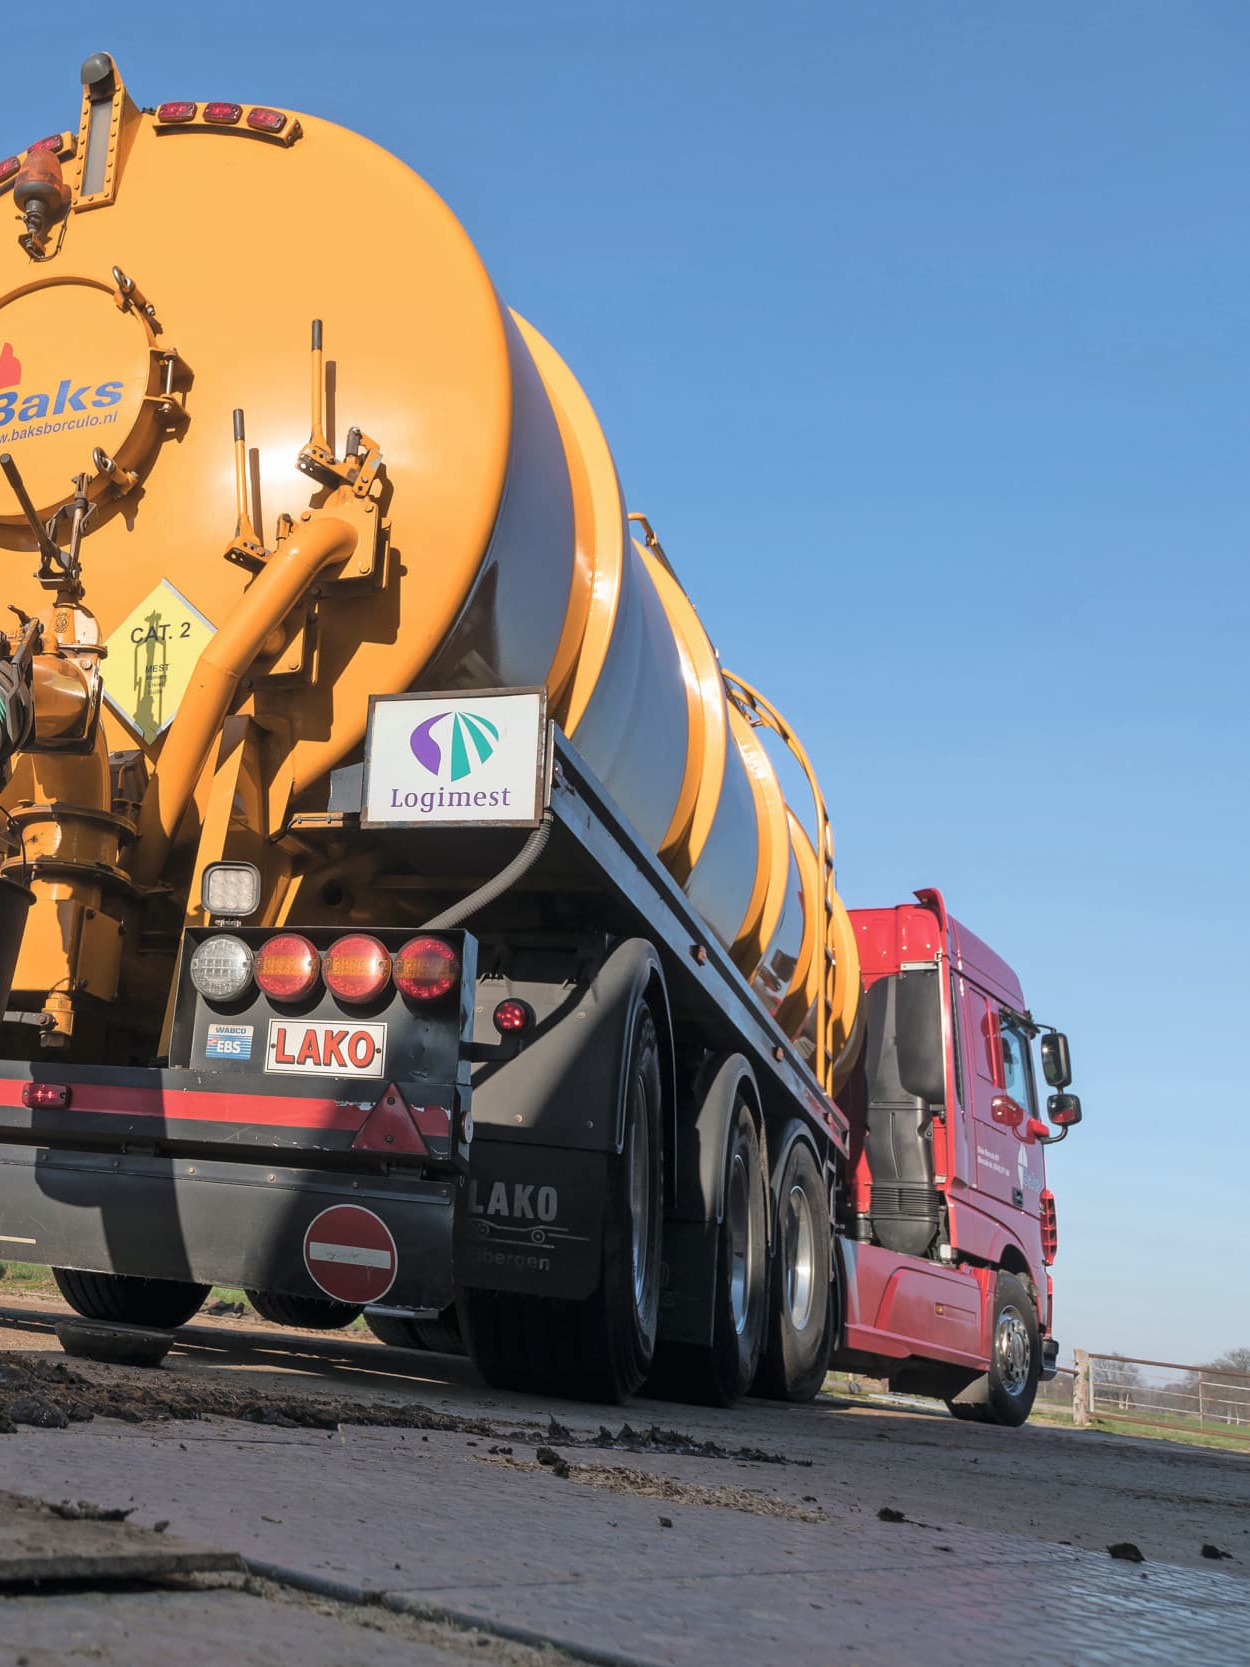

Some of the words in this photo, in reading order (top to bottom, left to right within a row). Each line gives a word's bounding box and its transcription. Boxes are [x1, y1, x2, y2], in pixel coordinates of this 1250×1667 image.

[130, 623, 173, 644] CAT.
[179, 621, 191, 639] 2
[390, 786, 511, 813] Logimest
[215, 1026, 247, 1035] WABCO
[216, 1040, 241, 1054] EBS
[275, 1028, 376, 1069] LAKO
[469, 1178, 558, 1222] LAKO
